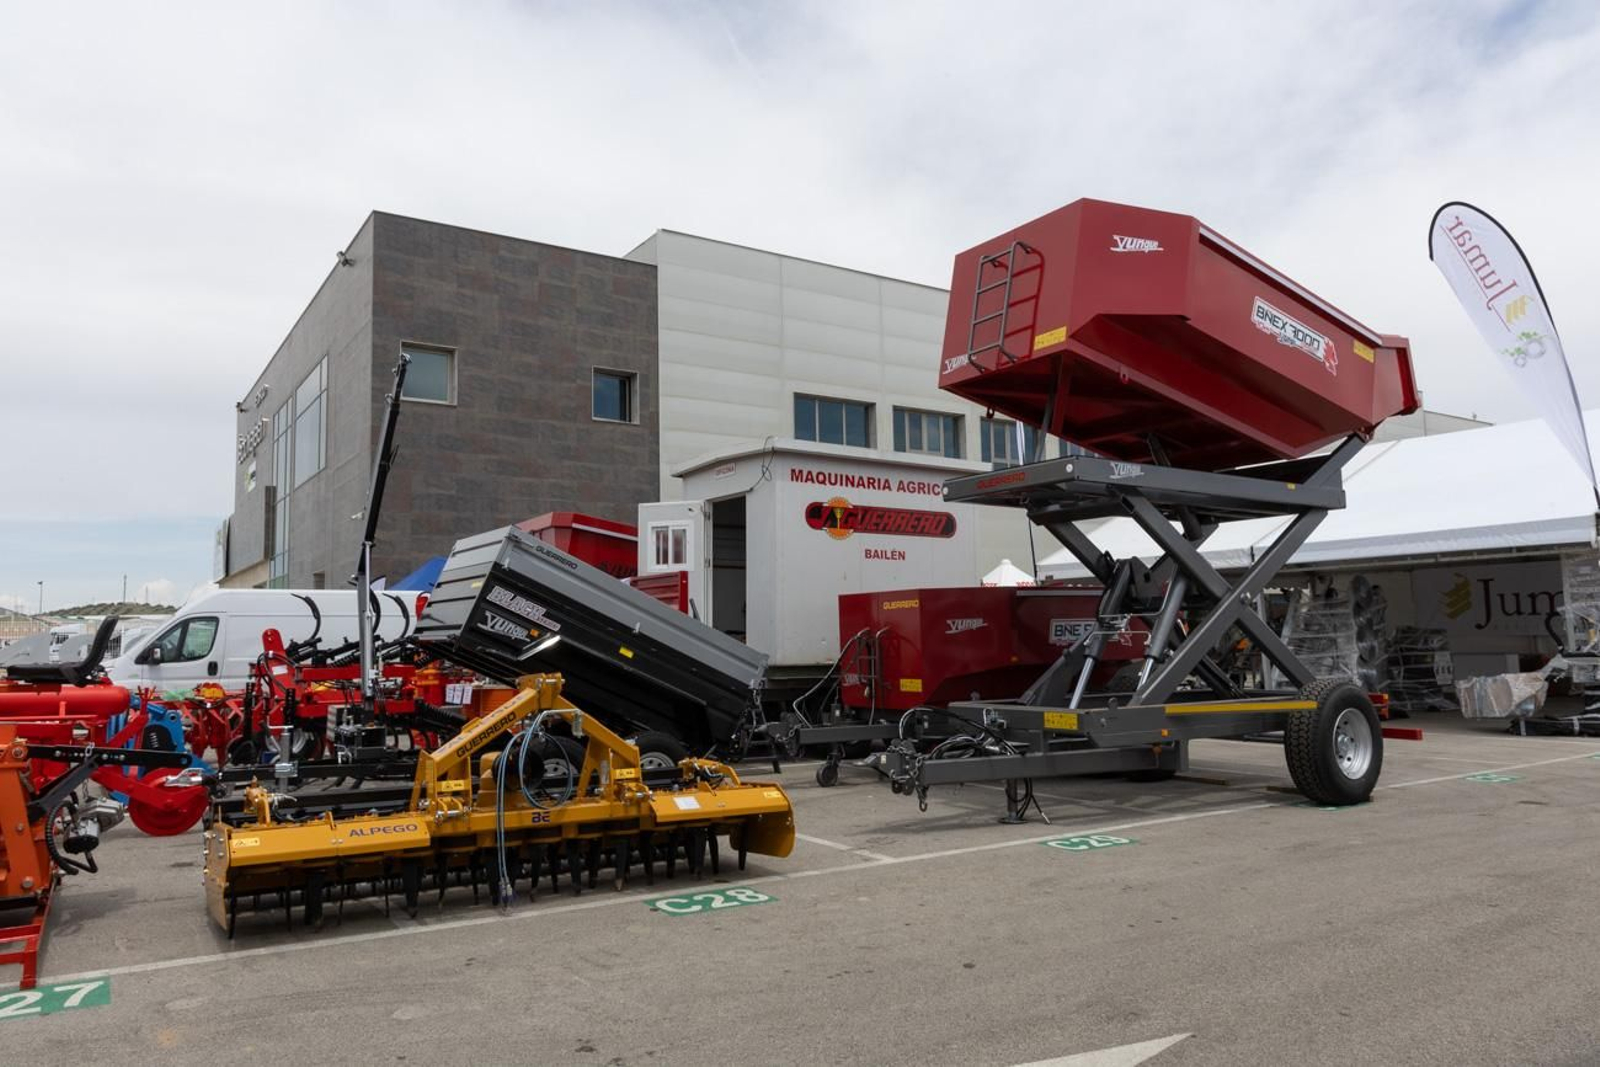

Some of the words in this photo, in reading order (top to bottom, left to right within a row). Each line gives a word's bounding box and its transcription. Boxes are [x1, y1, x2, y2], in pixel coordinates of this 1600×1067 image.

[790, 468, 893, 492] MAQUINARIA
[535, 545, 578, 570] GUERRERO
[864, 547, 906, 561] BAILÉN
[883, 599, 919, 610] GUERRERO
[1054, 623, 1081, 637] BNE
[456, 711, 517, 758] GUERRERO
[349, 823, 418, 838] ALPEGO
[655, 888, 769, 913] C28
